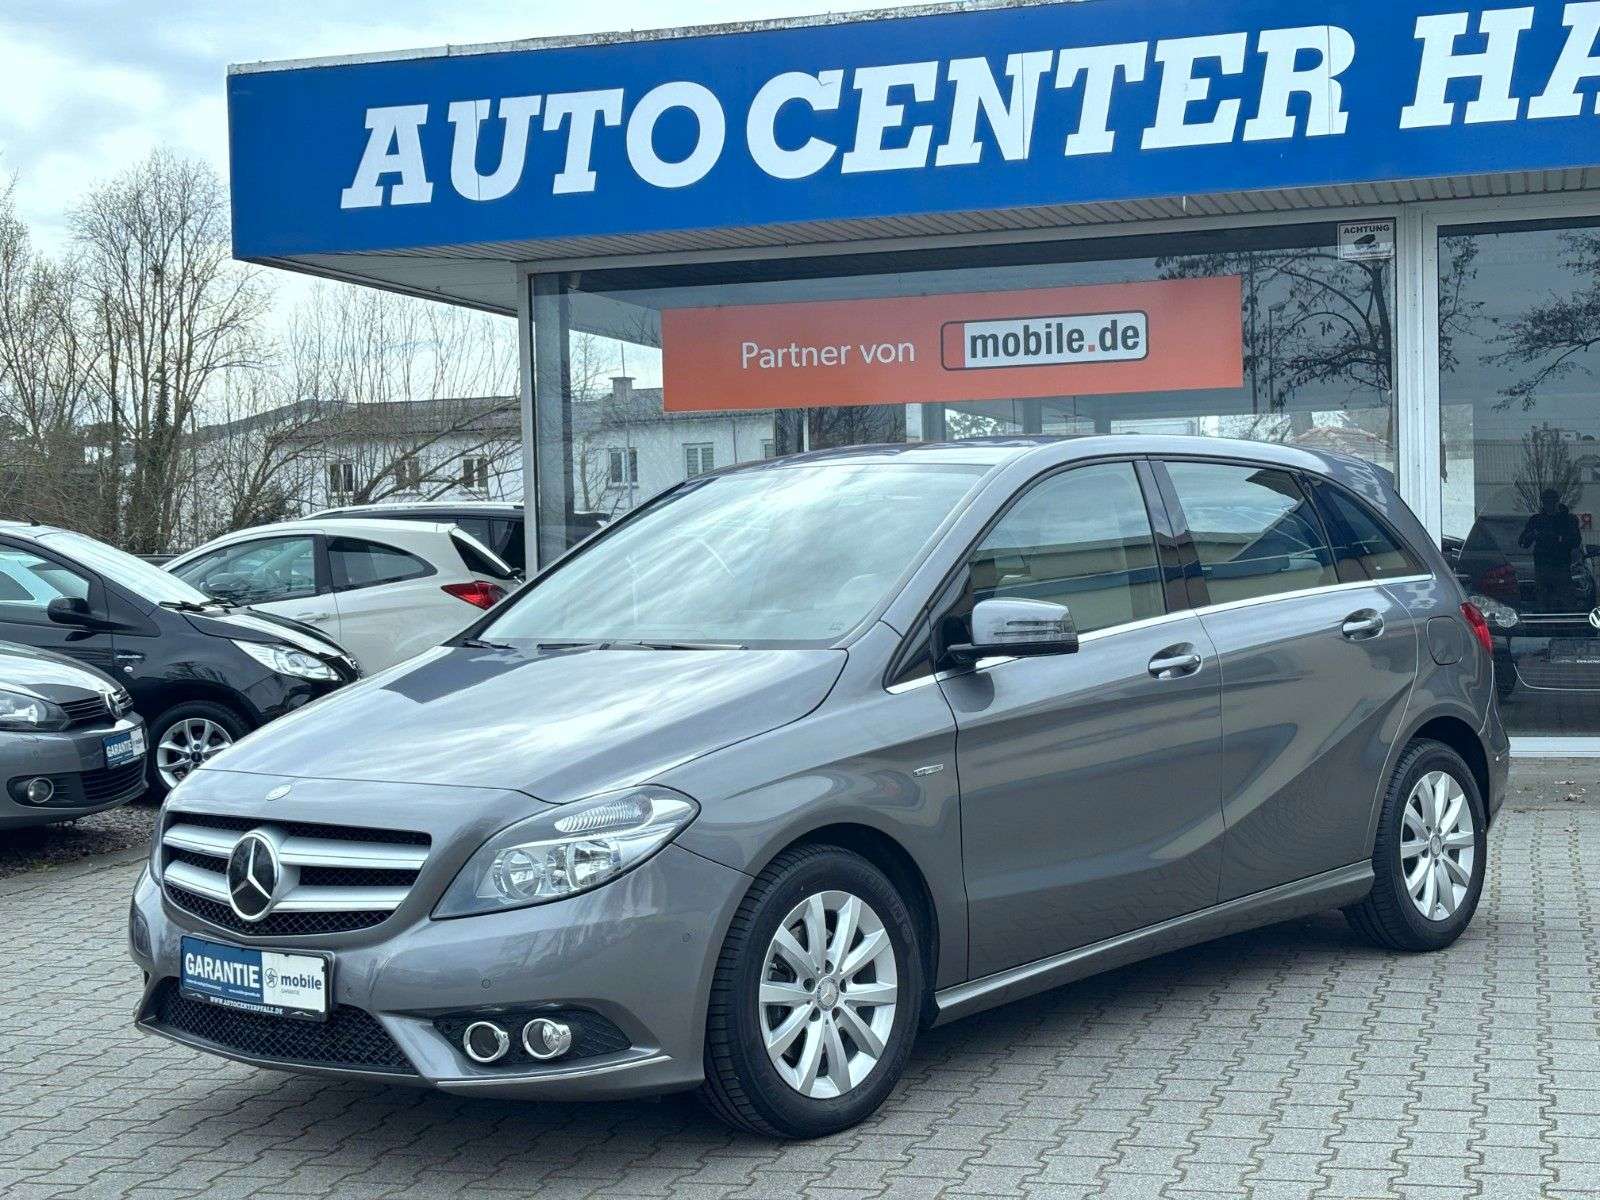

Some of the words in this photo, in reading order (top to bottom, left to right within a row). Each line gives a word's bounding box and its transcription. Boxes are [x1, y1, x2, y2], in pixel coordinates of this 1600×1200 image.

[1343, 224, 1390, 234] ACHTUNG
[741, 341, 851, 369] Partner
[859, 337, 916, 364] von
[969, 319, 1140, 359] mobile.de
[185, 952, 260, 988] GARANTIE
[280, 974, 322, 990] mobile
